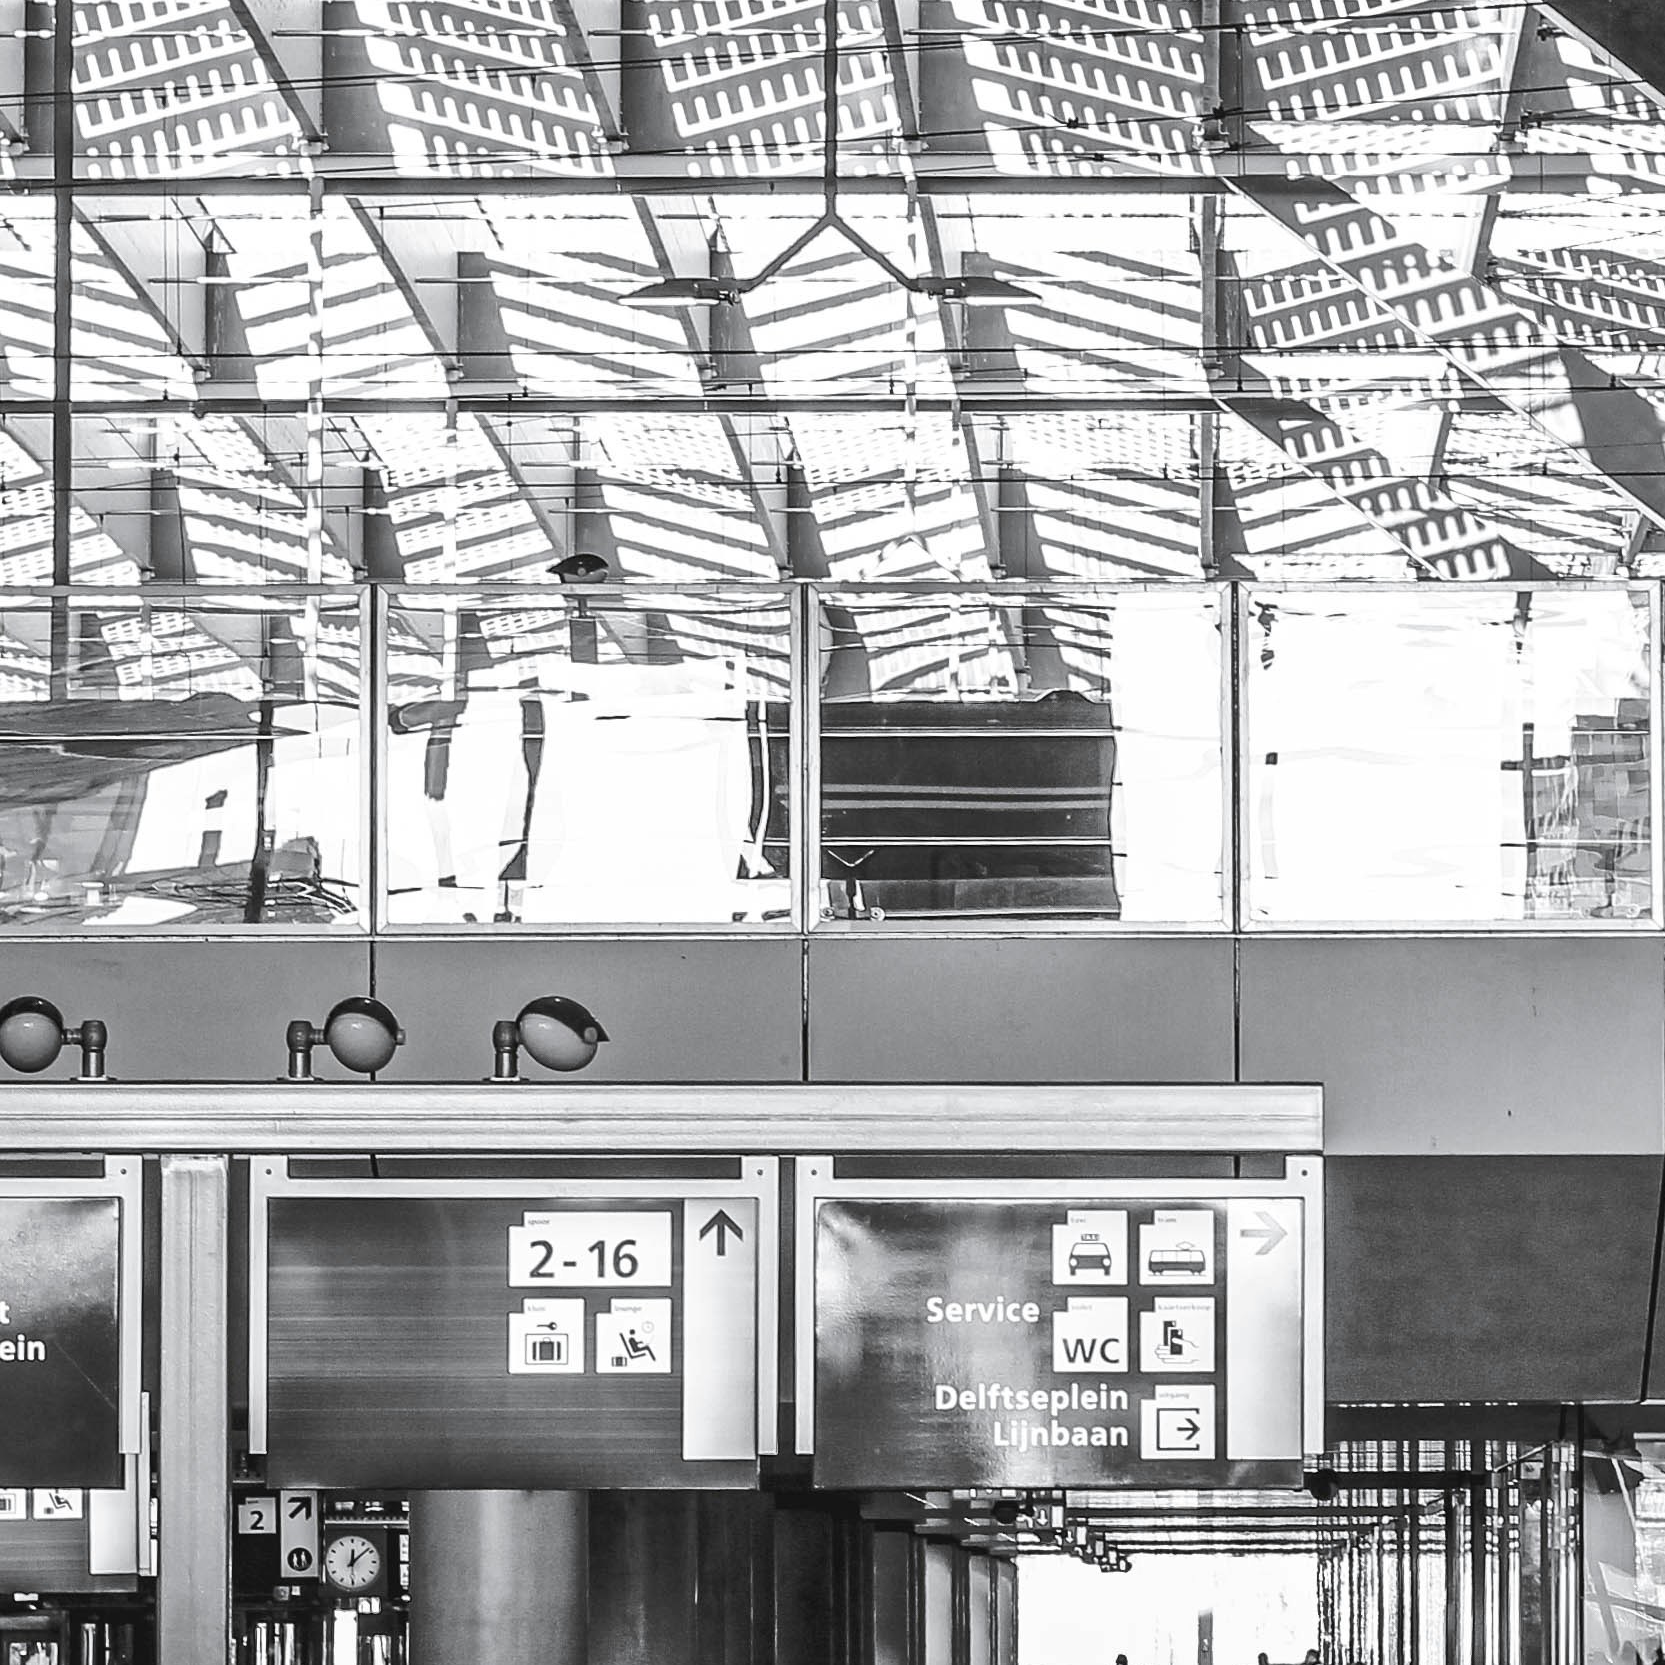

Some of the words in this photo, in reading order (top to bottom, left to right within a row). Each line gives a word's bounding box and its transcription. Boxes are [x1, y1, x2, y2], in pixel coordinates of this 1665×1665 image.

[926, 1297, 1040, 1323] Service
[1062, 1338, 1120, 1364] WC
[934, 1383, 1128, 1417] Delftseplein
[993, 1420, 1128, 1451] Lijnbaan
[250, 1510, 263, 1530] 2
